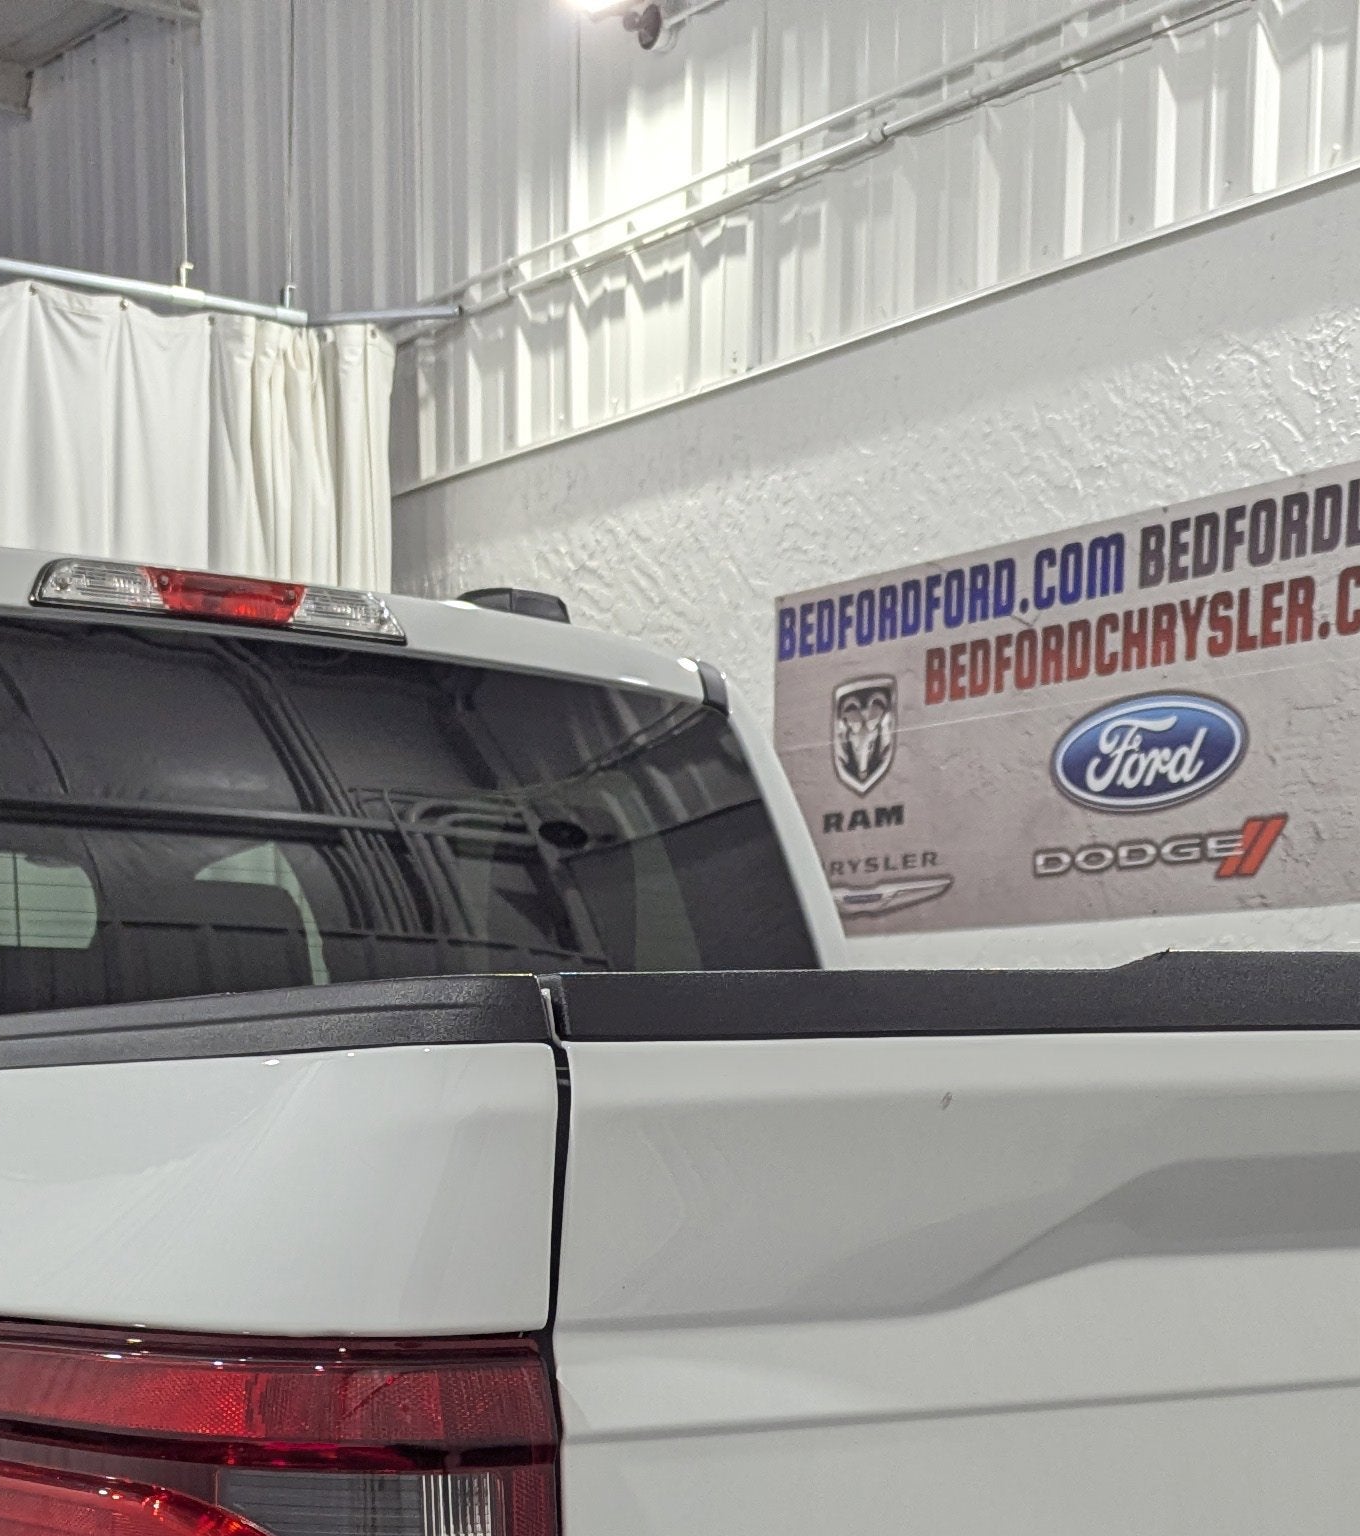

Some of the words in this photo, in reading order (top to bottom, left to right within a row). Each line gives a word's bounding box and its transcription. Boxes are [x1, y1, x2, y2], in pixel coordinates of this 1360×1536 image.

[777, 532, 1125, 663] BEDFORDFORD.COM
[1086, 714, 1208, 793] Ford
[822, 804, 905, 835] RAM
[823, 851, 939, 877] RYSLER
[1033, 831, 1245, 879] DODGE
